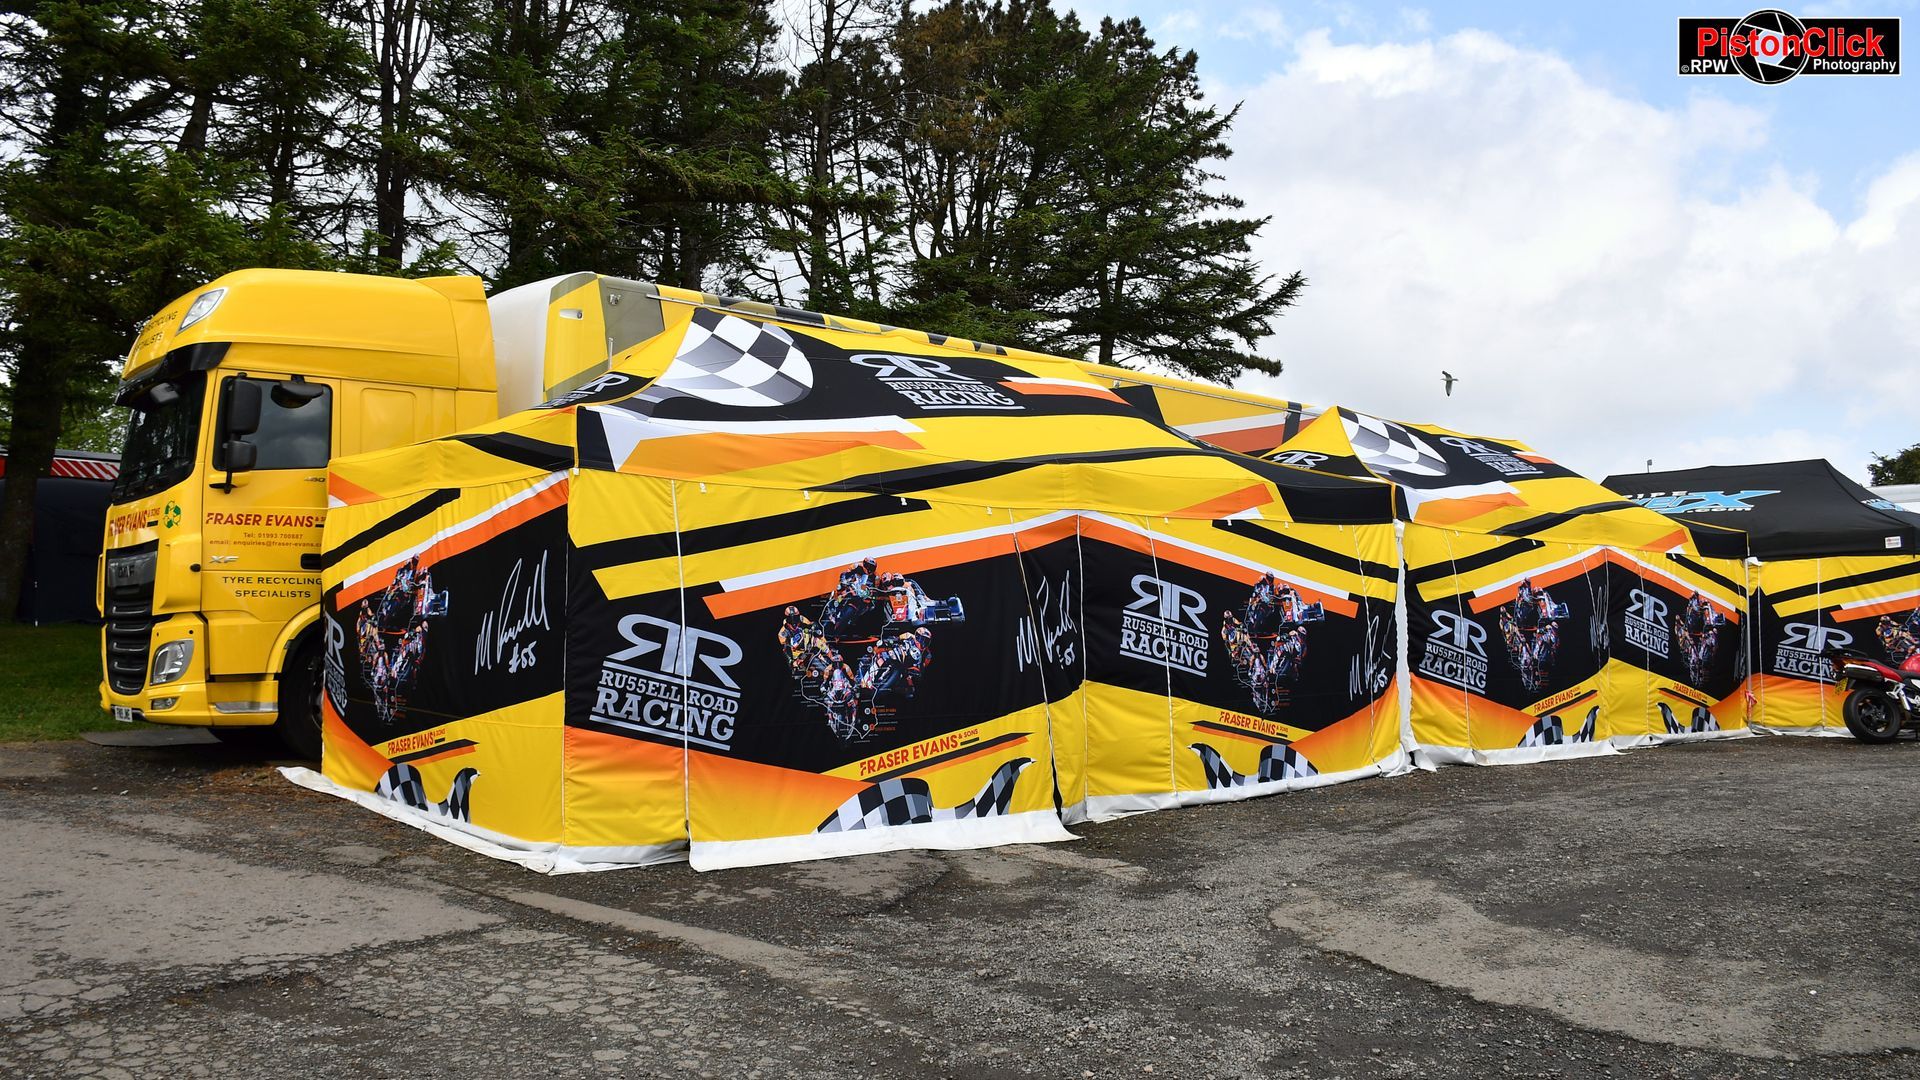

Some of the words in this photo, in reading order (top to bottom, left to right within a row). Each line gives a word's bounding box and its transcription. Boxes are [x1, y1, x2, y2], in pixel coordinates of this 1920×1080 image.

[897, 390, 1015, 406] RACING
[206, 512, 262, 526] FRASER
[265, 514, 314, 528] EVANS
[209, 555, 239, 564] XF
[222, 576, 253, 585] TYRE
[235, 589, 311, 598] SPECIALISTS
[1120, 628, 1208, 670] RACING
[1178, 631, 1209, 650] ROAD
[1624, 624, 1669, 654] RACING
[1418, 652, 1487, 689] RACING
[1466, 656, 1488, 673] ROAD
[687, 689, 739, 715] ROAD
[1533, 697, 1555, 713] FRASER
[1555, 689, 1574, 705] EVANS
[592, 686, 736, 741] RACING
[1219, 711, 1251, 729] FRASER
[1252, 719, 1277, 736] EVANS
[387, 737, 412, 755] FRASER
[412, 731, 434, 750] EVANS
[859, 748, 909, 777] FRASER
[912, 735, 959, 760] EVANS
[963, 728, 979, 738] SONS
